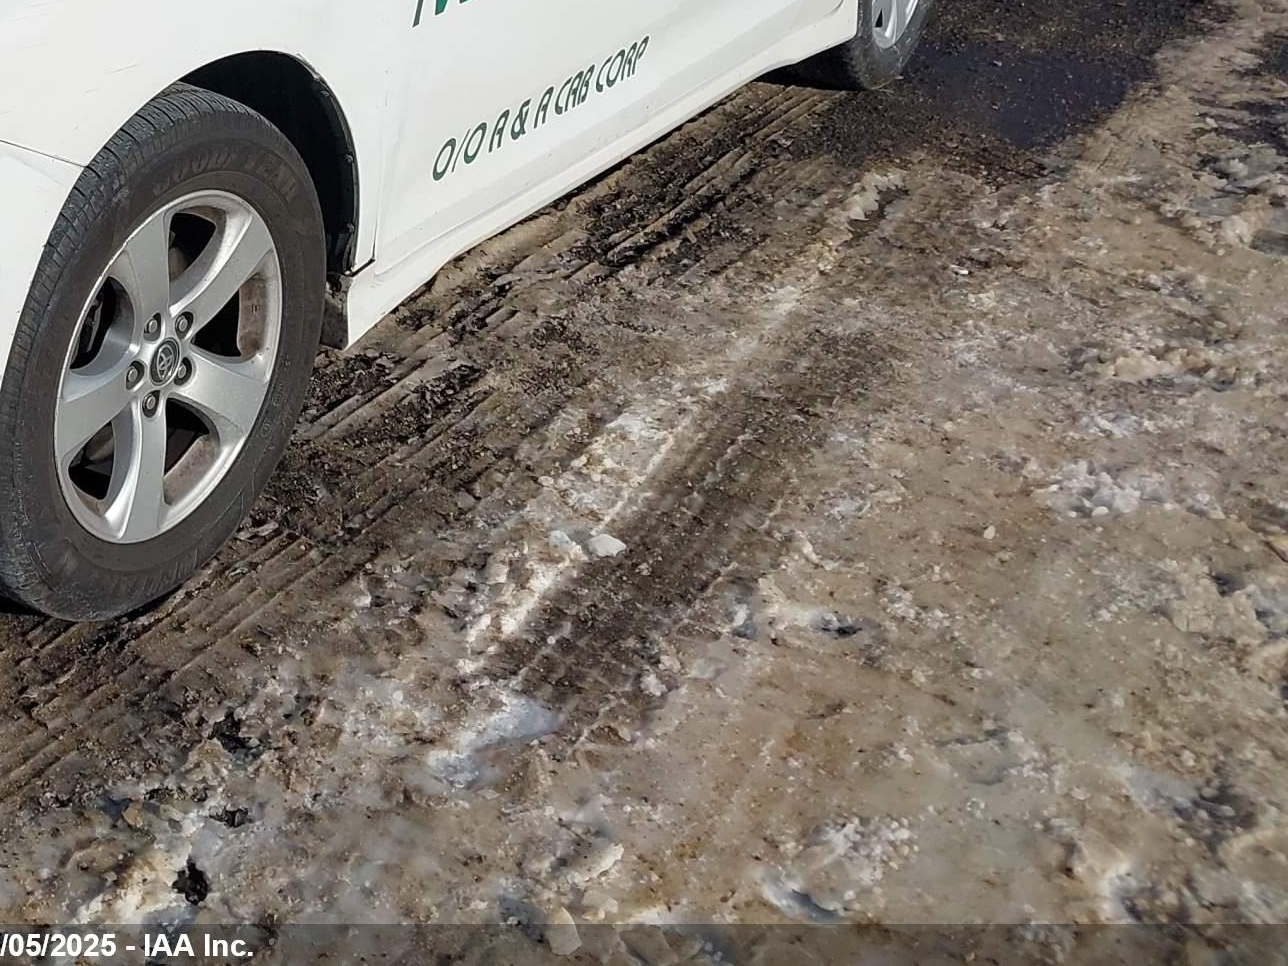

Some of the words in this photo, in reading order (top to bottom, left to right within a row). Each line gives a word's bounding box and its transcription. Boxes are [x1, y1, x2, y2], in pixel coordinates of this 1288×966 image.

[432, 122, 488, 181] O/O
[510, 98, 532, 140] &
[555, 64, 596, 115] CAB
[595, 35, 650, 93] CORP
